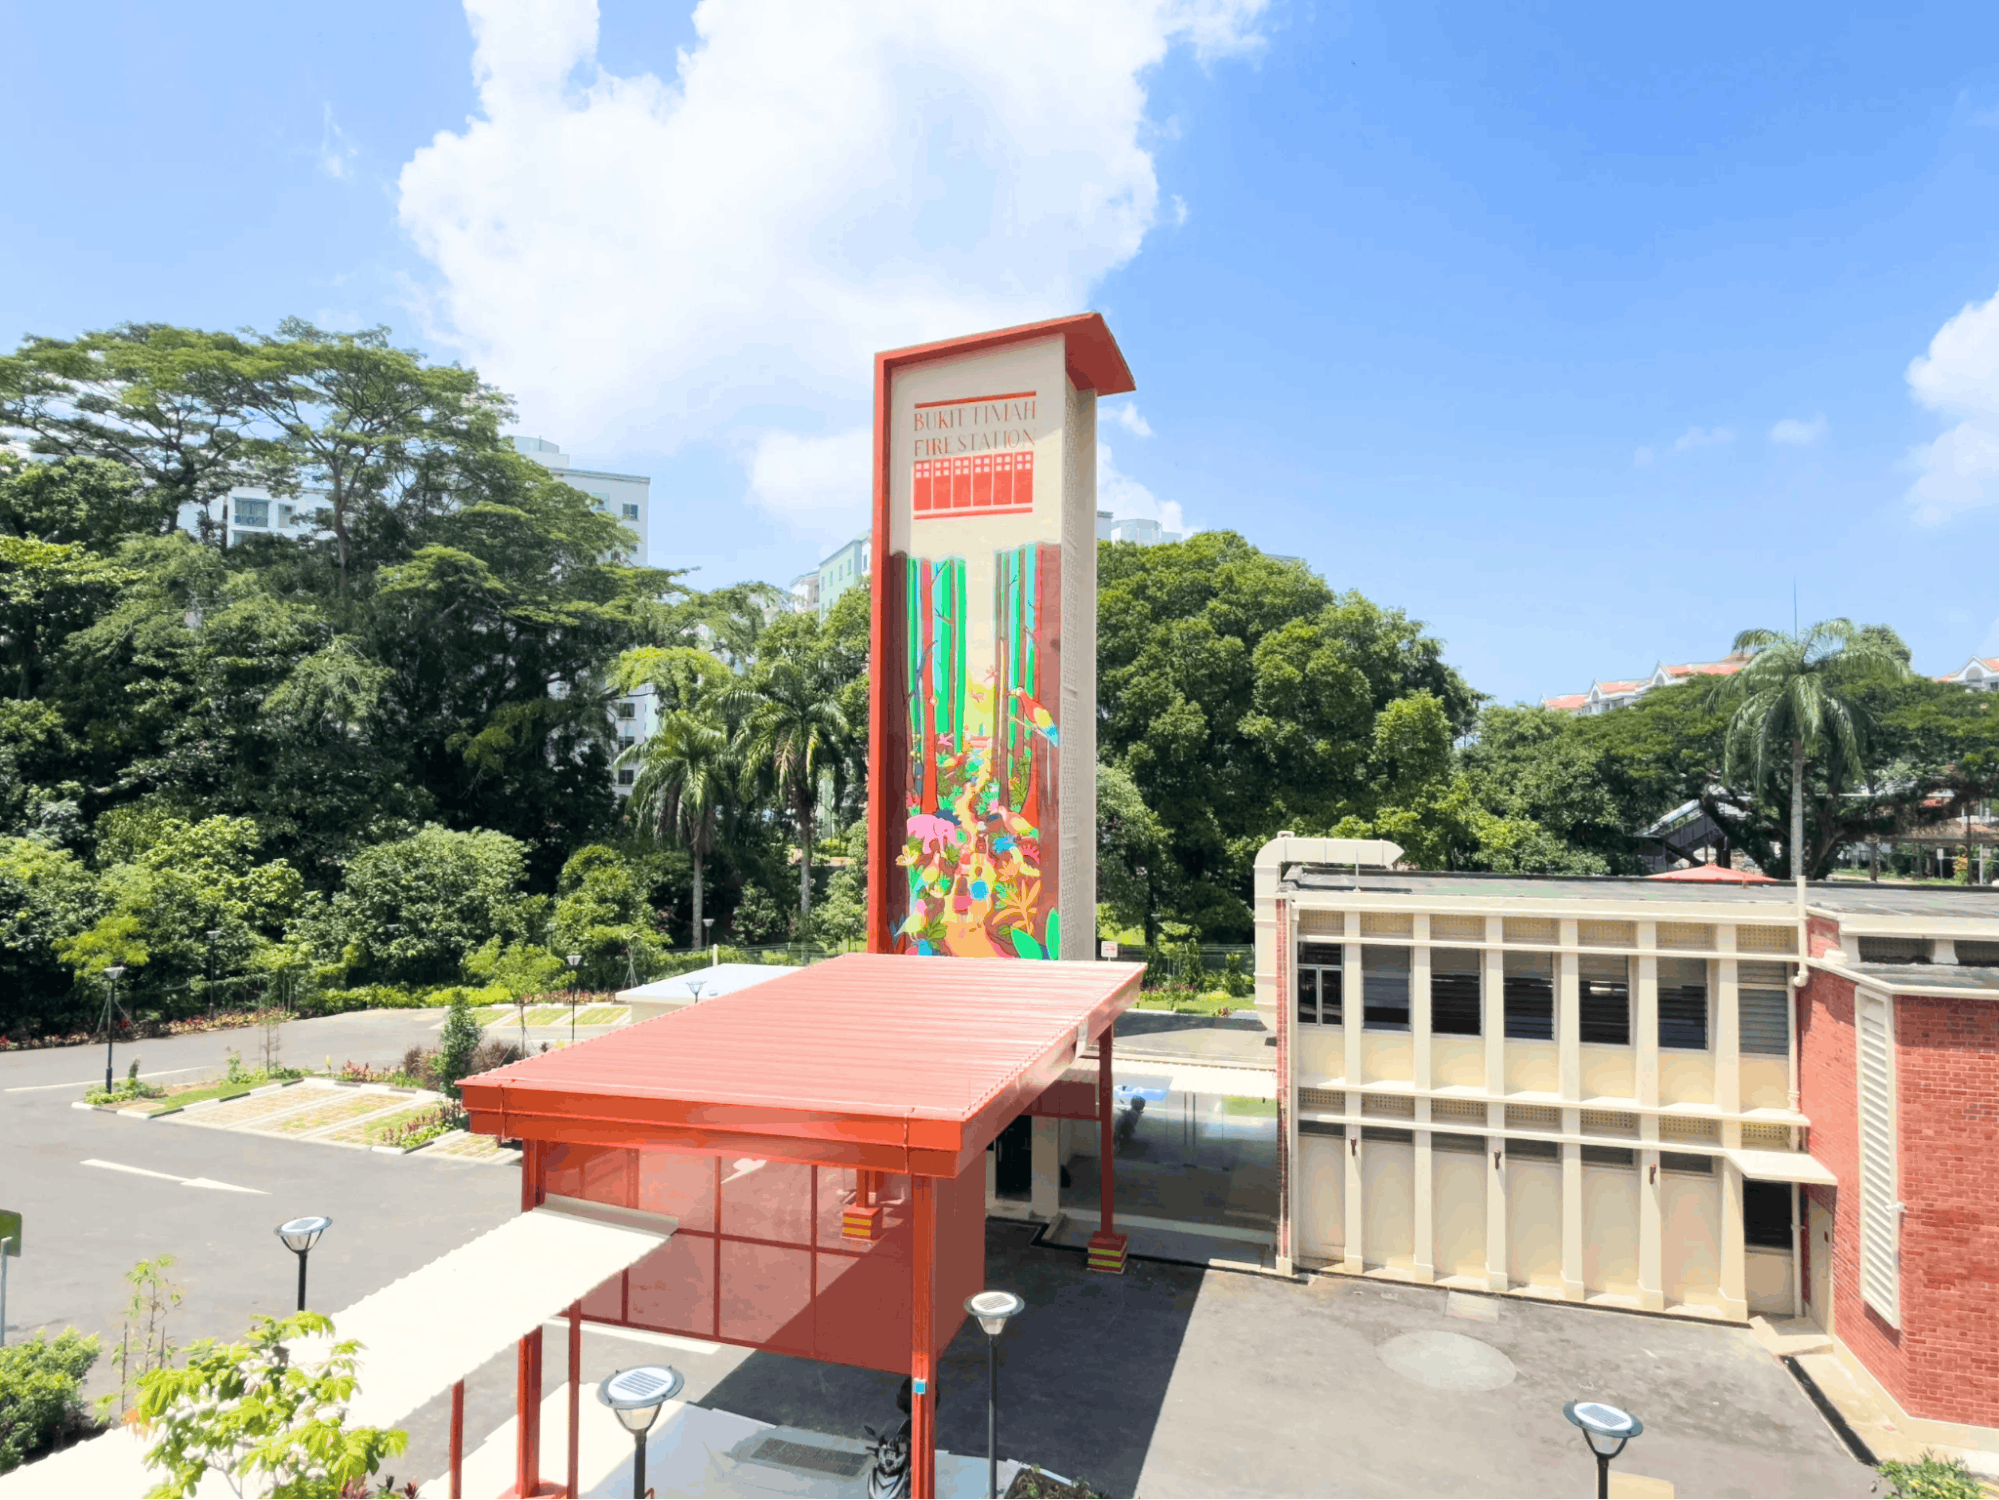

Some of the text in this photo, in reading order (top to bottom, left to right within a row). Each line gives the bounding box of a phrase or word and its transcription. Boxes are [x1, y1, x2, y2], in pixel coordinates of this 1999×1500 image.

[914, 401, 1036, 431] BUKIT TIMAH
[914, 428, 1036, 457] FIRE STATION
